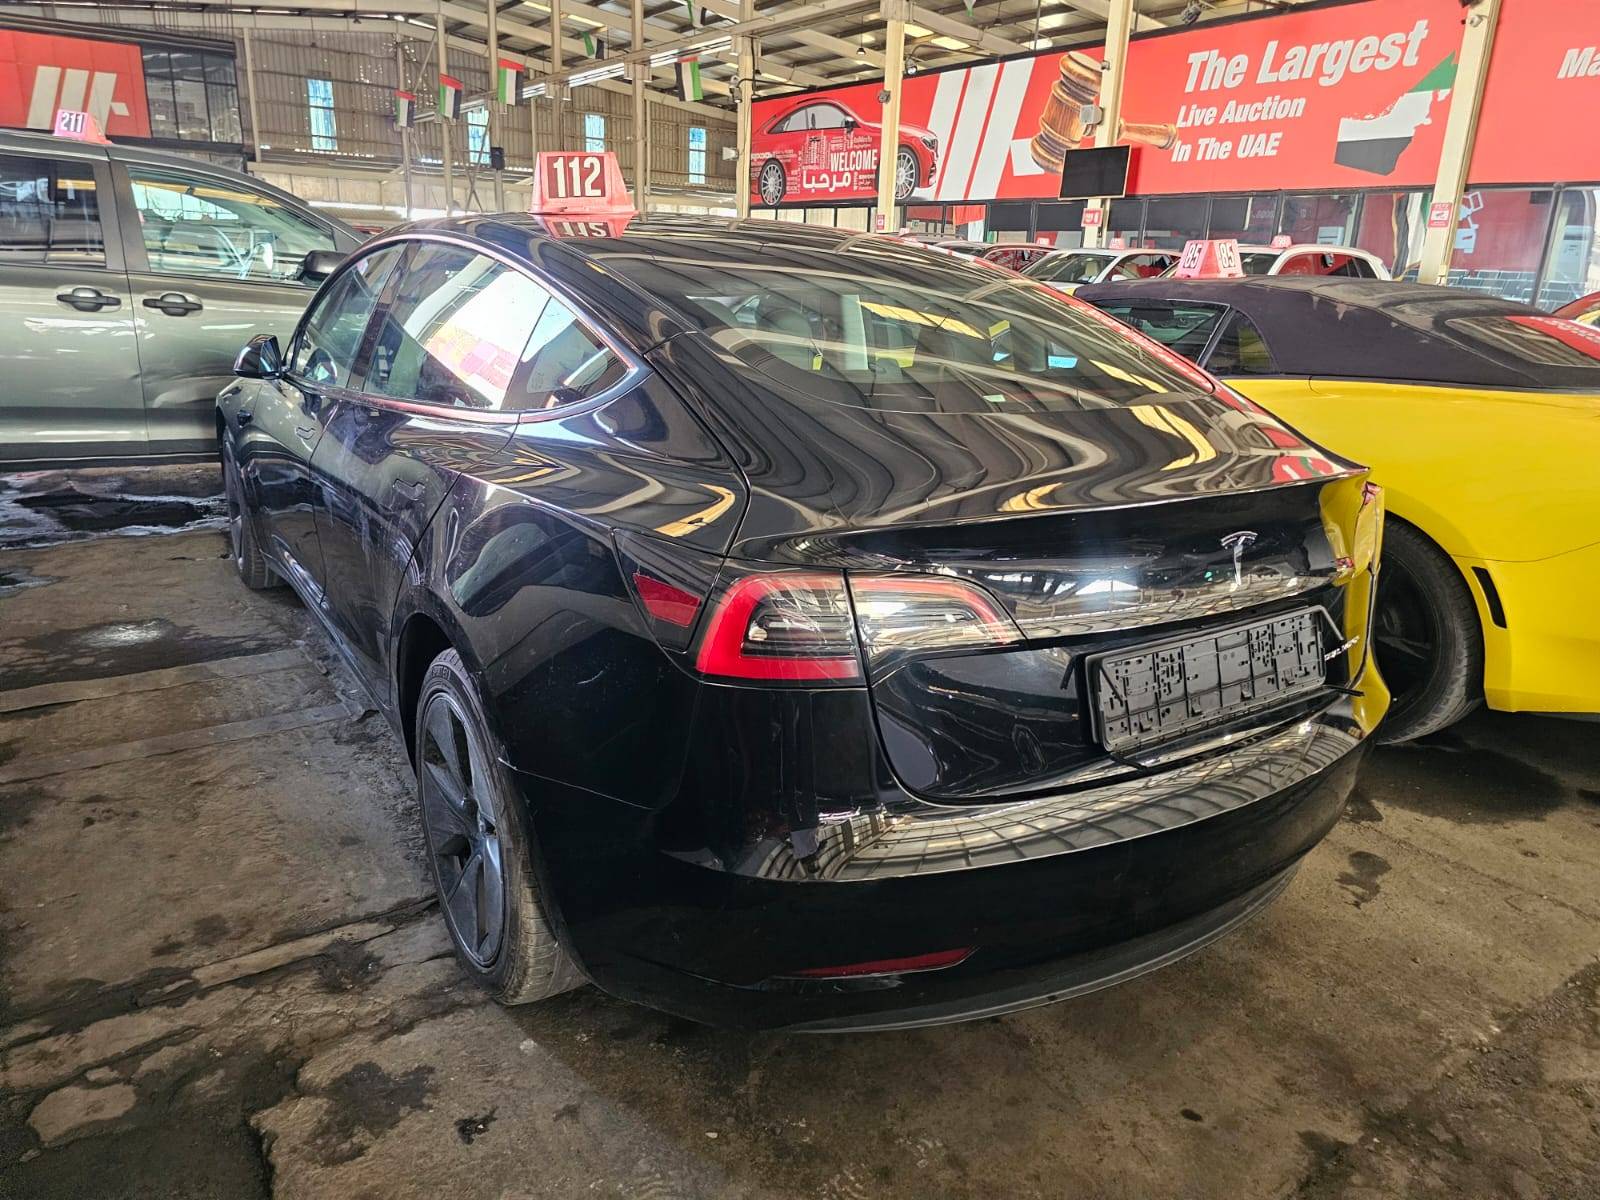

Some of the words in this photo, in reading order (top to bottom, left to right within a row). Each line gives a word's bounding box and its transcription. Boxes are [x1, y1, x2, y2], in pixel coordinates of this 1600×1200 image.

[1184, 49, 1249, 93] The
[1256, 19, 1429, 87] Largest
[60, 112, 84, 133] 211
[1176, 104, 1217, 128] Live
[1219, 95, 1306, 124] Auction
[1171, 140, 1192, 162] In
[1196, 137, 1232, 161] The
[1237, 132, 1282, 158] UAE
[831, 149, 877, 171] WELCOME
[553, 156, 602, 198] 112
[803, 172, 851, 193] مرحبا
[1184, 243, 1203, 268] 85
[1219, 243, 1235, 268] 85
